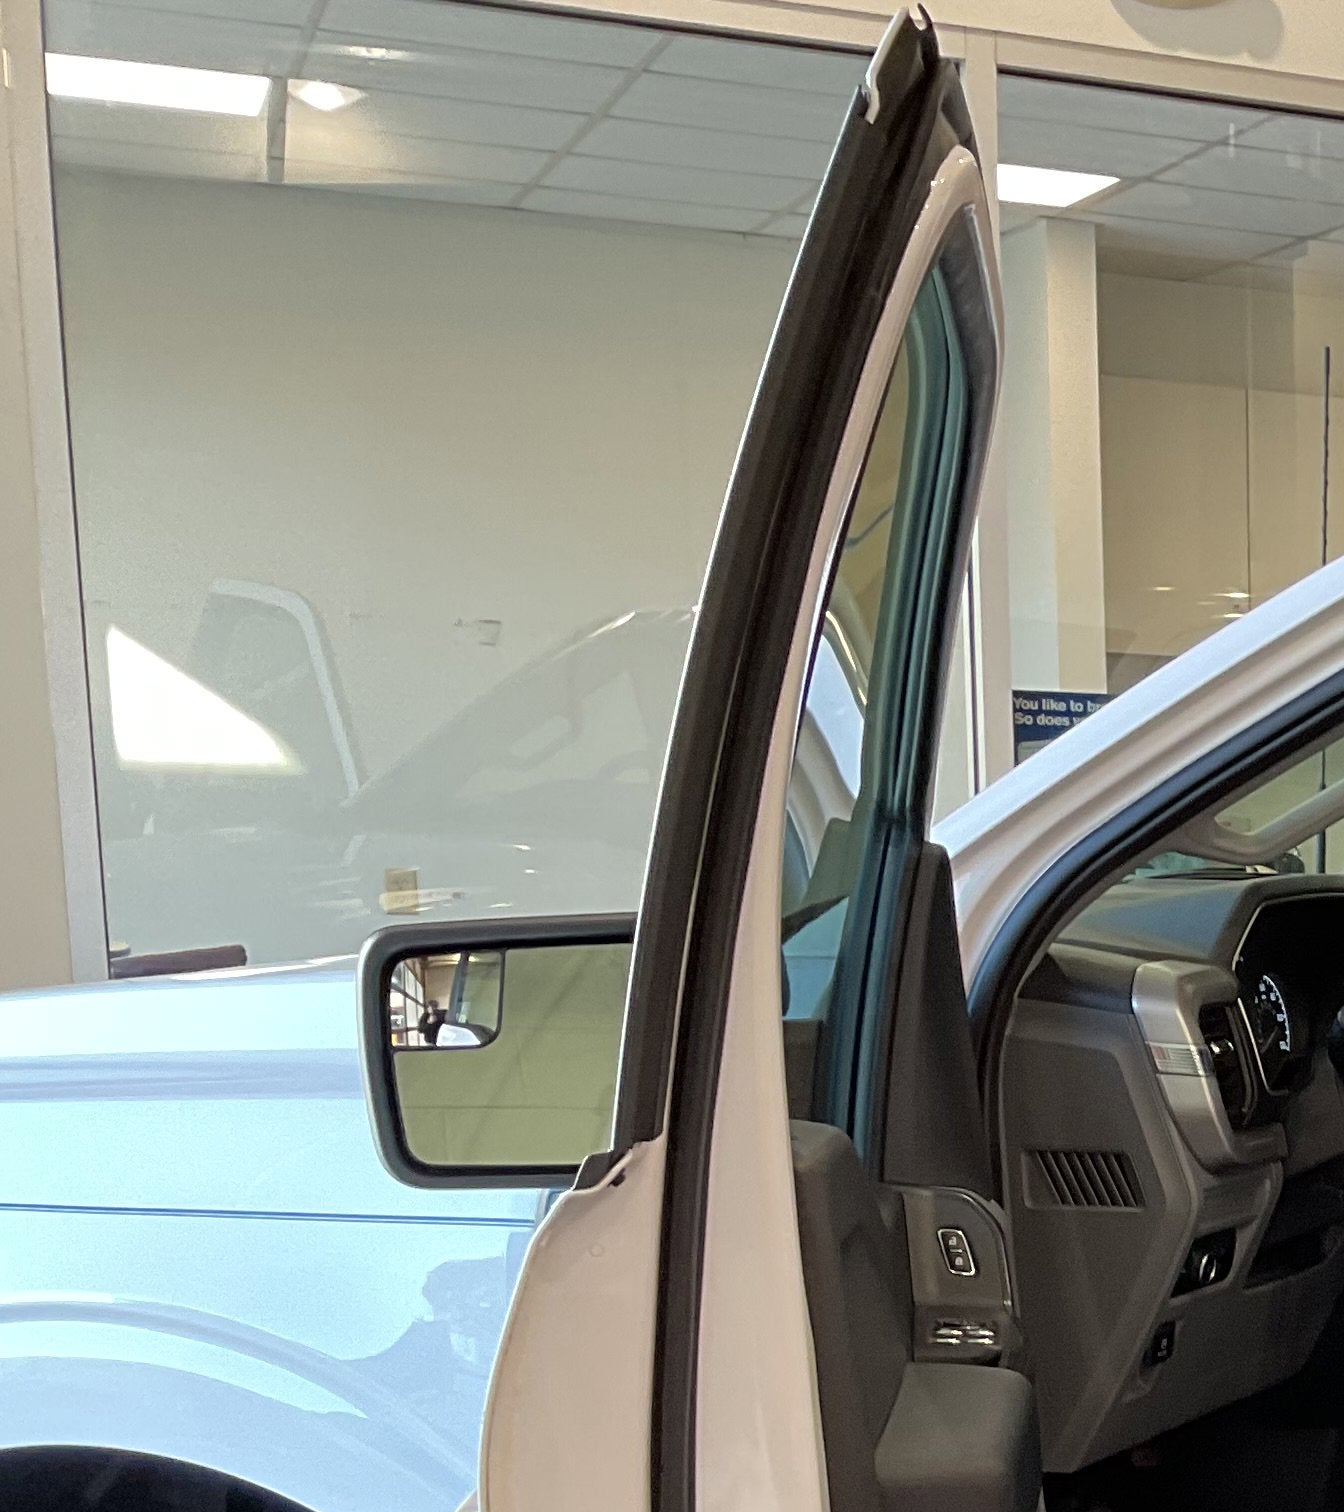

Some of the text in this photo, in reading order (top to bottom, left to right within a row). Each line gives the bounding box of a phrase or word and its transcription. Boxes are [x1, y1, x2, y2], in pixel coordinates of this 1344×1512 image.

[1013, 698, 1038, 710] You
[1041, 699, 1066, 711] like
[1070, 701, 1083, 712] to
[1014, 712, 1033, 725] So
[1037, 714, 1070, 726] does
